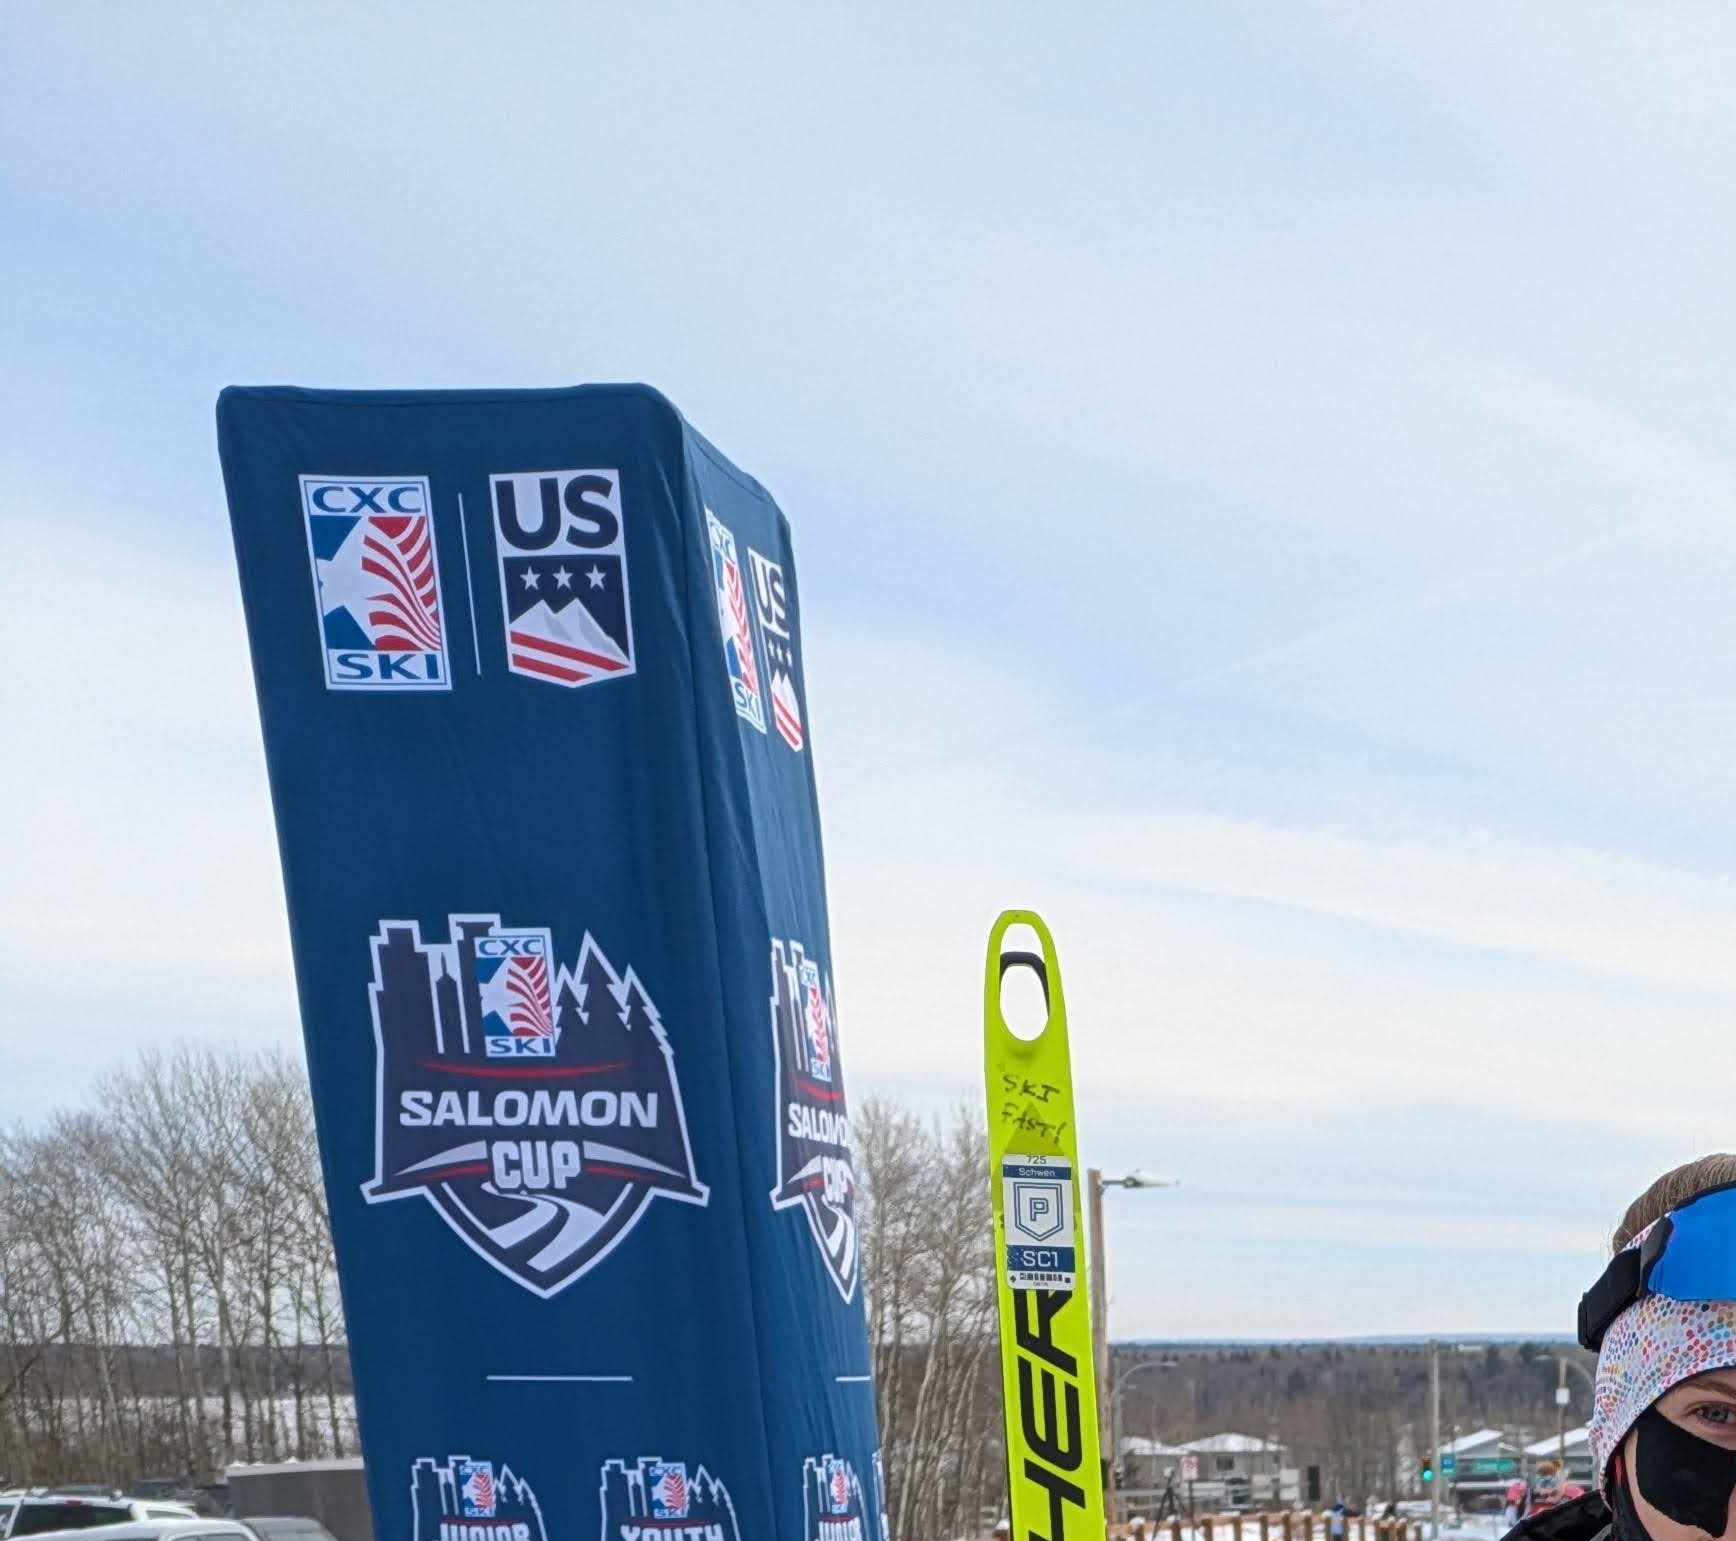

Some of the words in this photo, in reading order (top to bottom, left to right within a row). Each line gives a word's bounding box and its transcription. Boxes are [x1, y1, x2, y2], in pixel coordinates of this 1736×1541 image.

[311, 487, 422, 513] CXC
[498, 475, 619, 551] US
[336, 653, 441, 680] SKI
[479, 940, 544, 956] CXC
[488, 1039, 552, 1054] SKI
[1003, 1074, 1060, 1102] SKI
[400, 1091, 658, 1128] SALOMON
[788, 1103, 848, 1147] SALOMO
[492, 1141, 583, 1189] CUP
[1018, 1168, 1056, 1177] Schwen
[1026, 1156, 1047, 1164] 725
[1023, 1251, 1058, 1267] SC1
